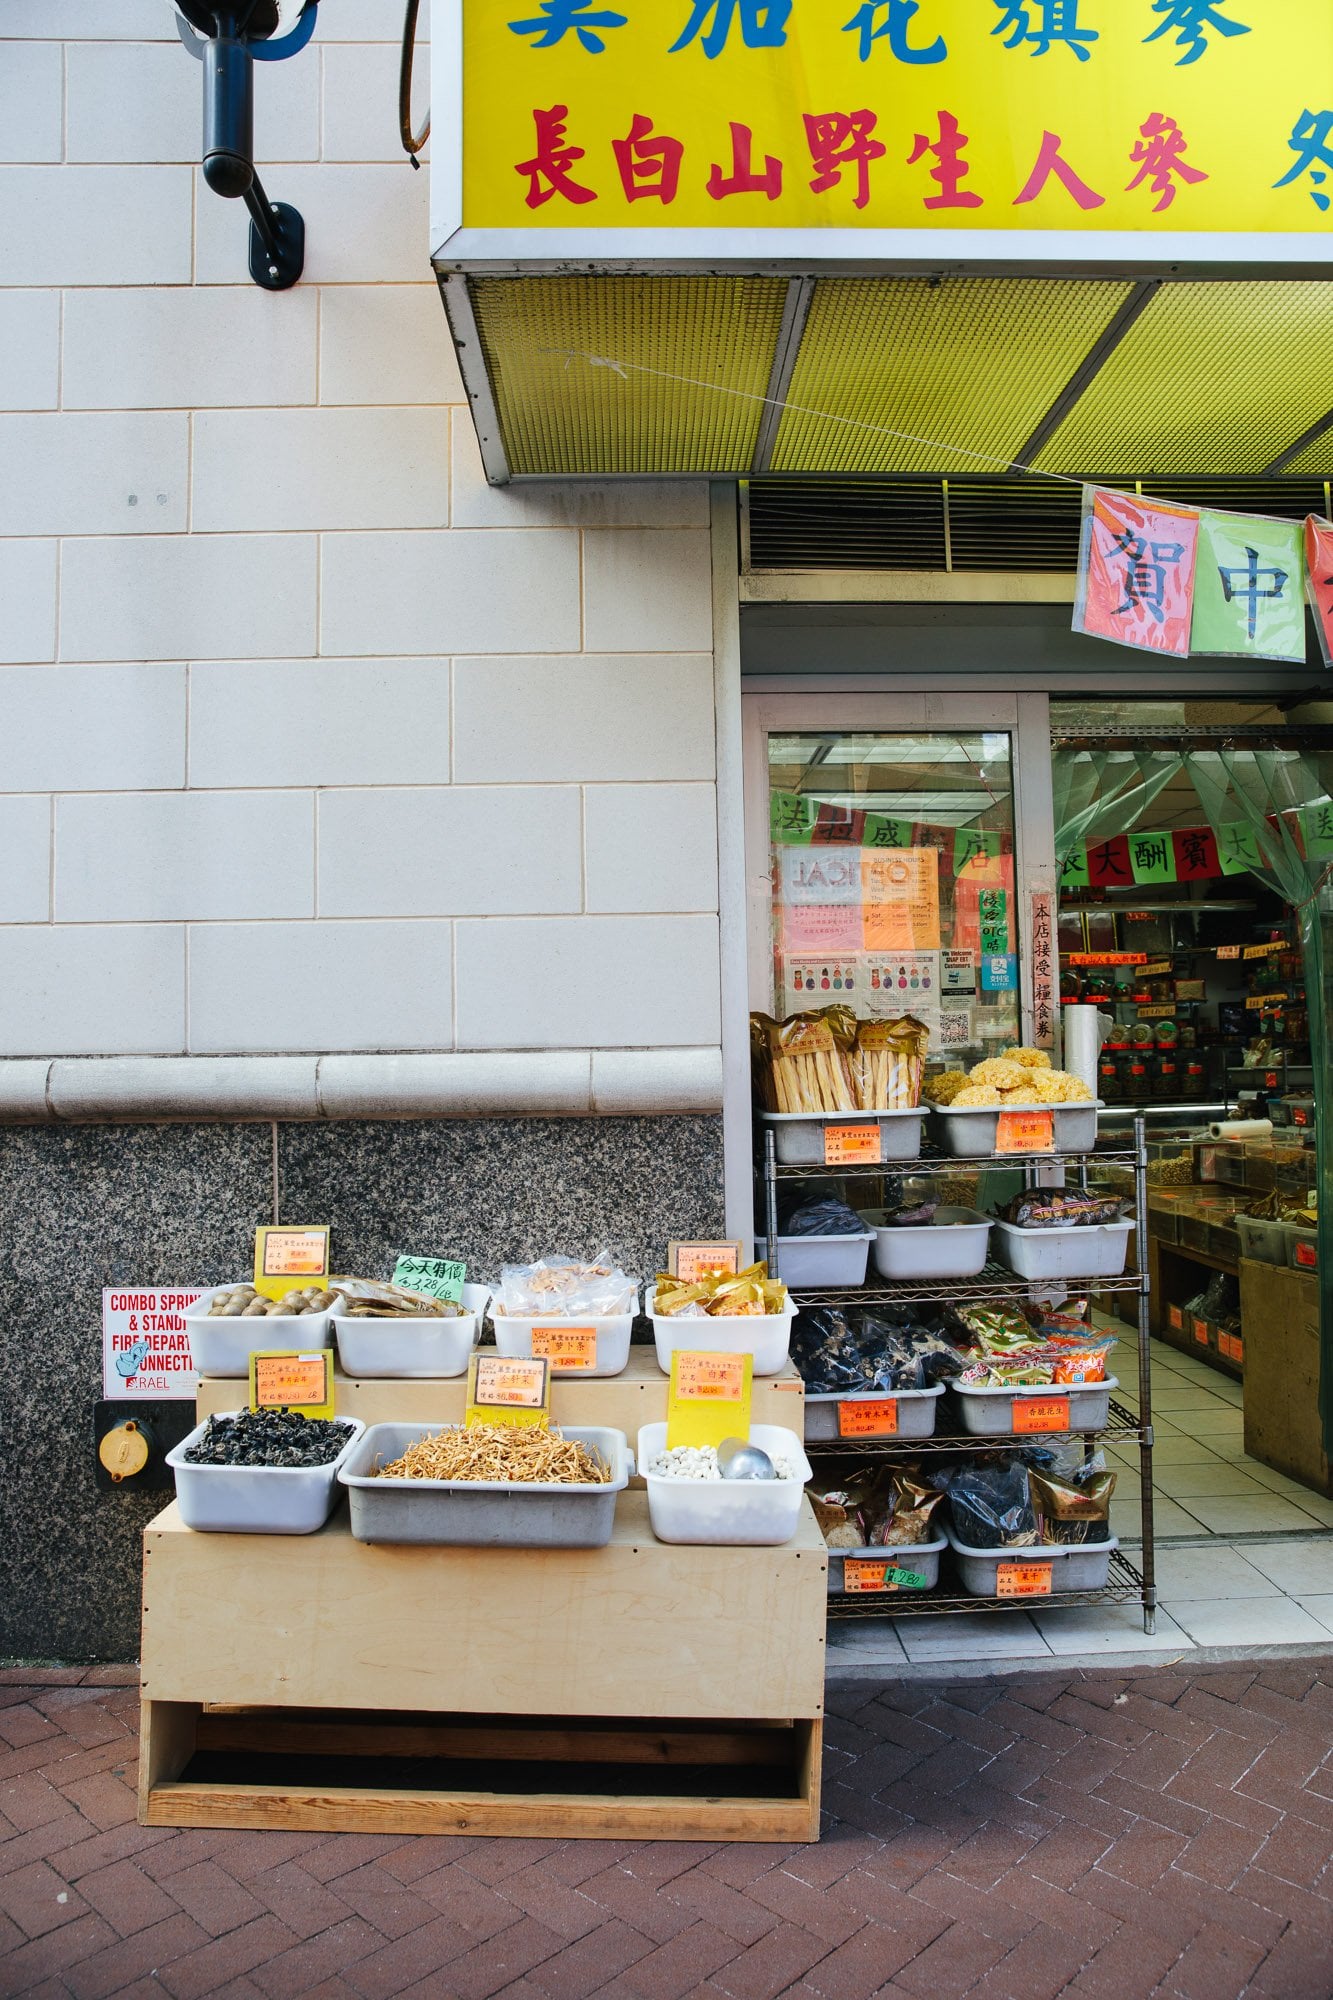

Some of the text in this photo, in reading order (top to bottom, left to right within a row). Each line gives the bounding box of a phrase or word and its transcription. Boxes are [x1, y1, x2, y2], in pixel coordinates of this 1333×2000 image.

[514, 105, 1210, 213] 長白山野生人參
[400, 1257, 464, 1282] 今天特價
[111, 1295, 156, 1311] COMBO
[129, 1315, 138, 1331] &
